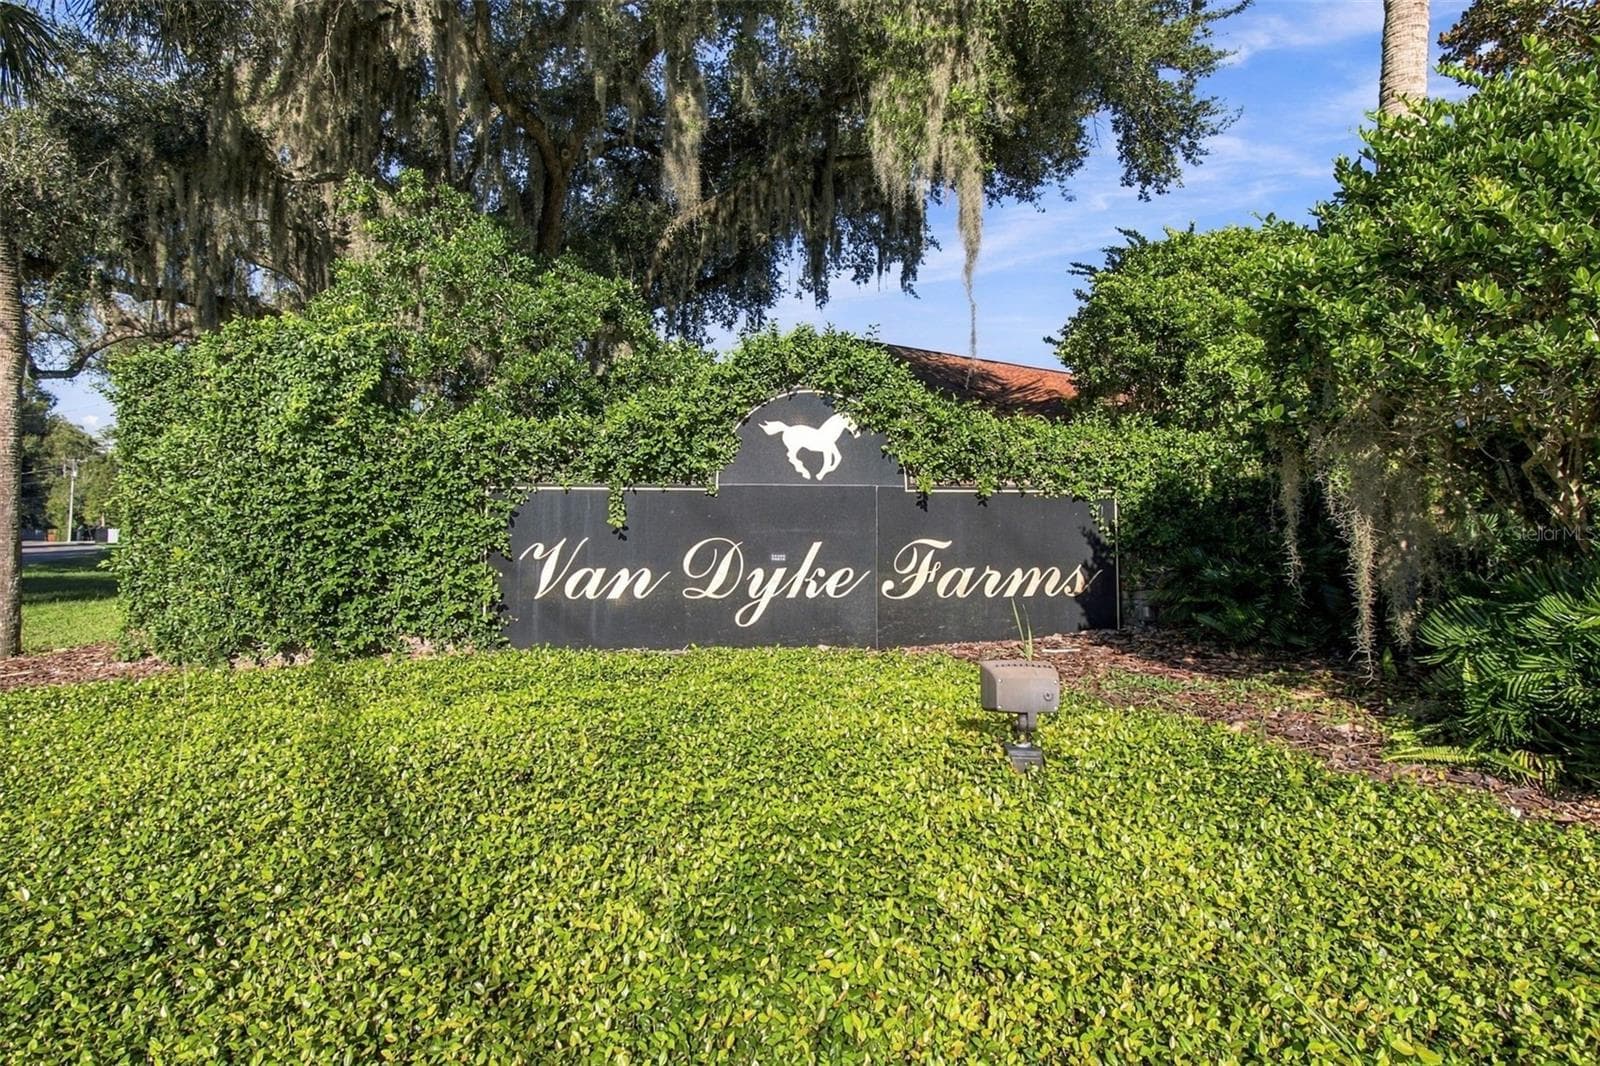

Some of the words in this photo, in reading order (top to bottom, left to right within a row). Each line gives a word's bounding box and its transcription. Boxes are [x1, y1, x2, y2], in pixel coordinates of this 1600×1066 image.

[519, 536, 671, 600] Van
[682, 536, 871, 628] Dyke
[881, 538, 1103, 600] Farms
